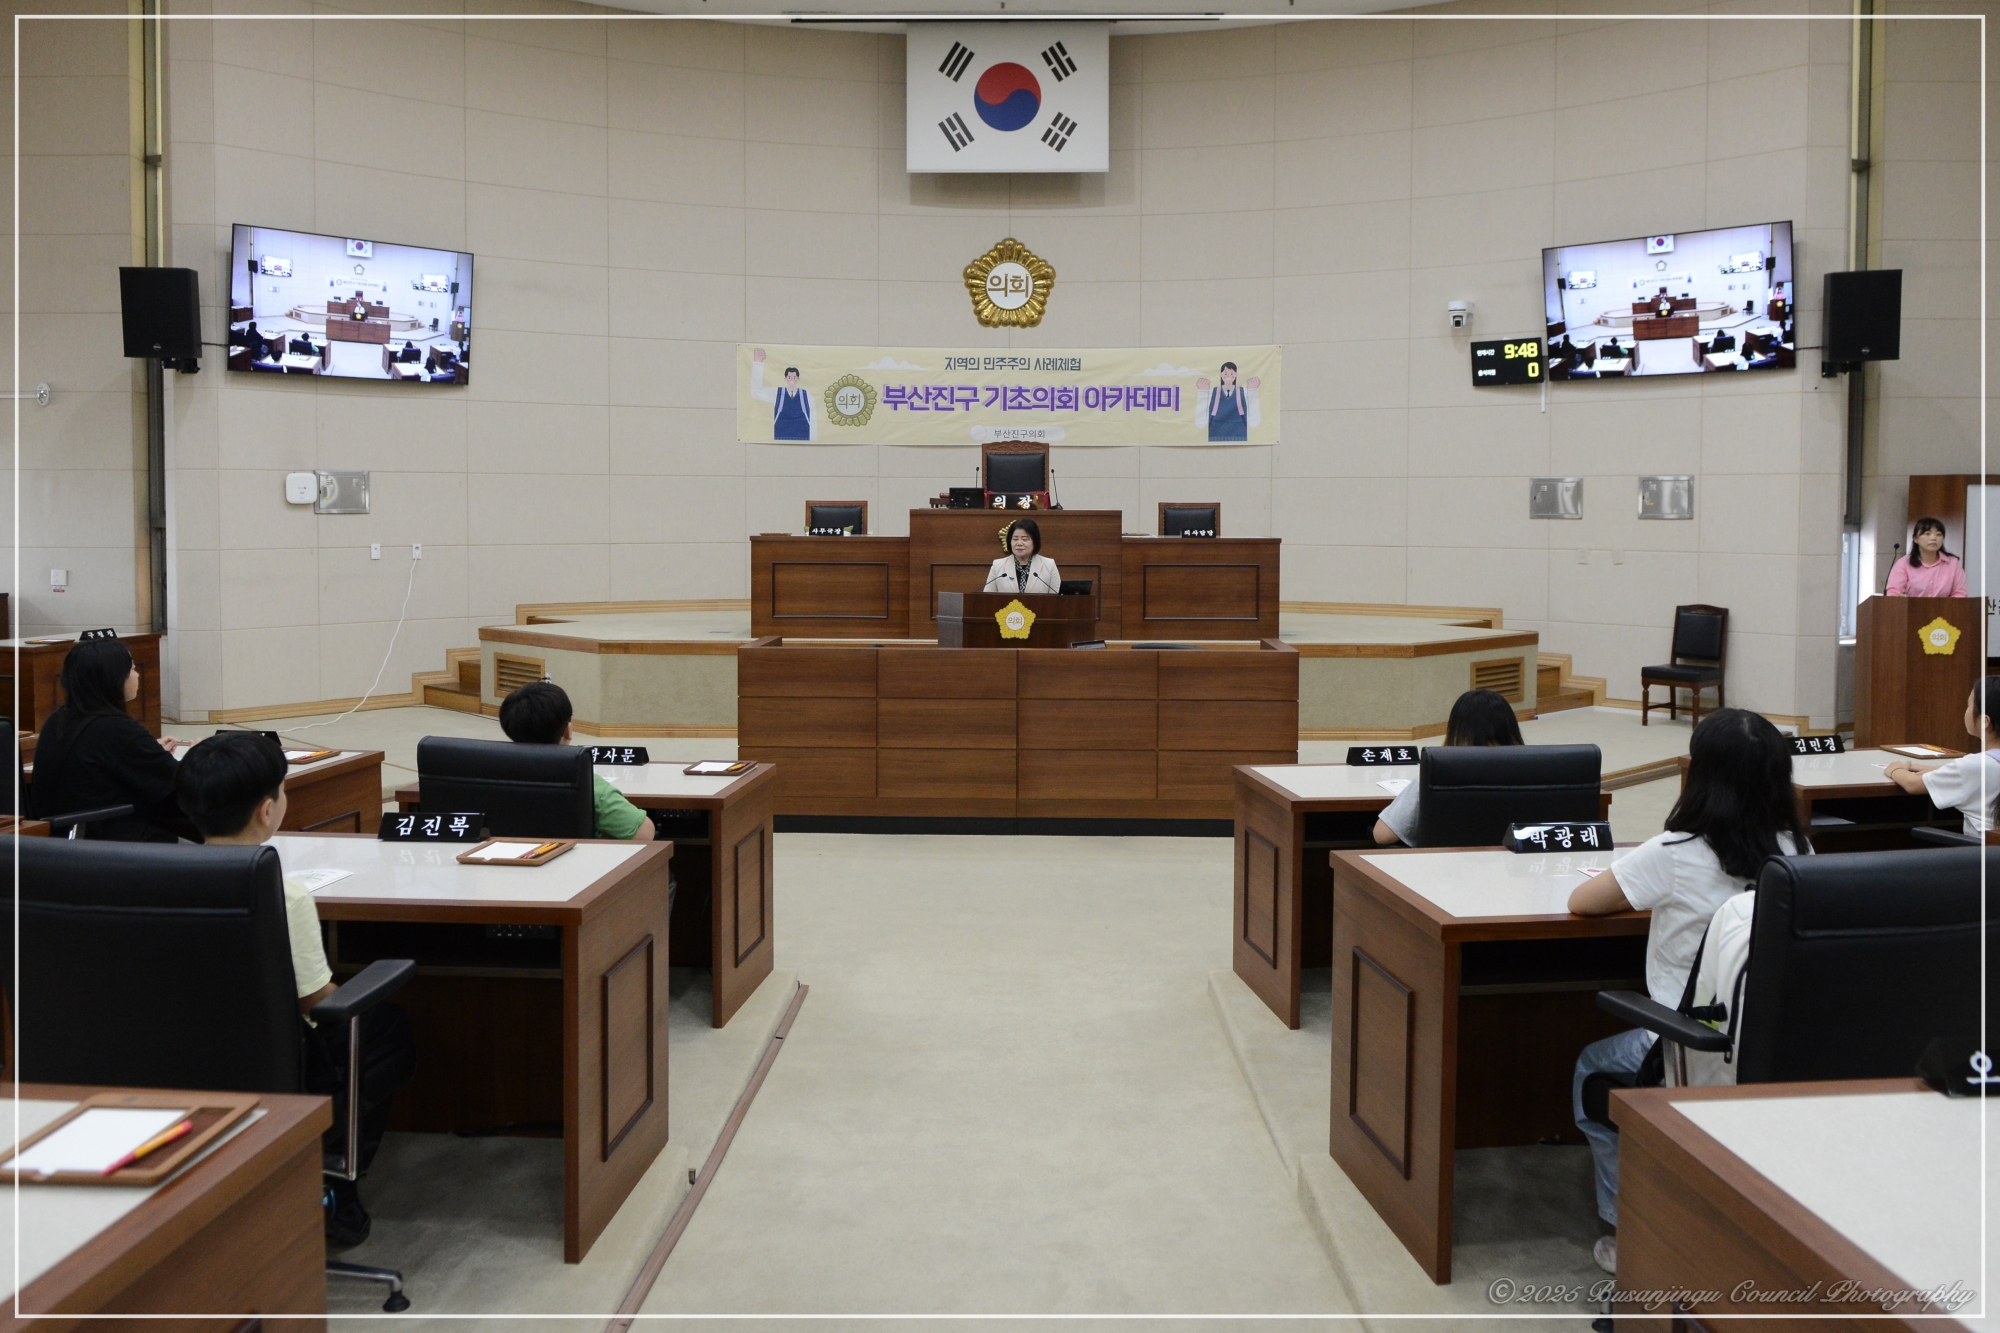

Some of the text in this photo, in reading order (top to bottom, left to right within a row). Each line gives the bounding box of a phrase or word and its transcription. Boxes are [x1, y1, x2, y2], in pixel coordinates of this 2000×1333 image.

[988, 273, 1030, 298] 의회
[1504, 342, 1538, 359] 9:48
[944, 357, 1081, 371] 지역의 민주주의 사례체험
[1527, 362, 1540, 377] 0
[837, 393, 861, 410] 의회
[882, 384, 1180, 412] 부산진구 기초의회 아카데미
[993, 429, 1046, 439] 부산진구의회
[1007, 616, 1023, 626] 의회
[1794, 737, 1836, 753] 김민경
[1361, 748, 1412, 762] 손재호
[395, 815, 470, 837] 김진복
[1530, 825, 1599, 849] 박광래
